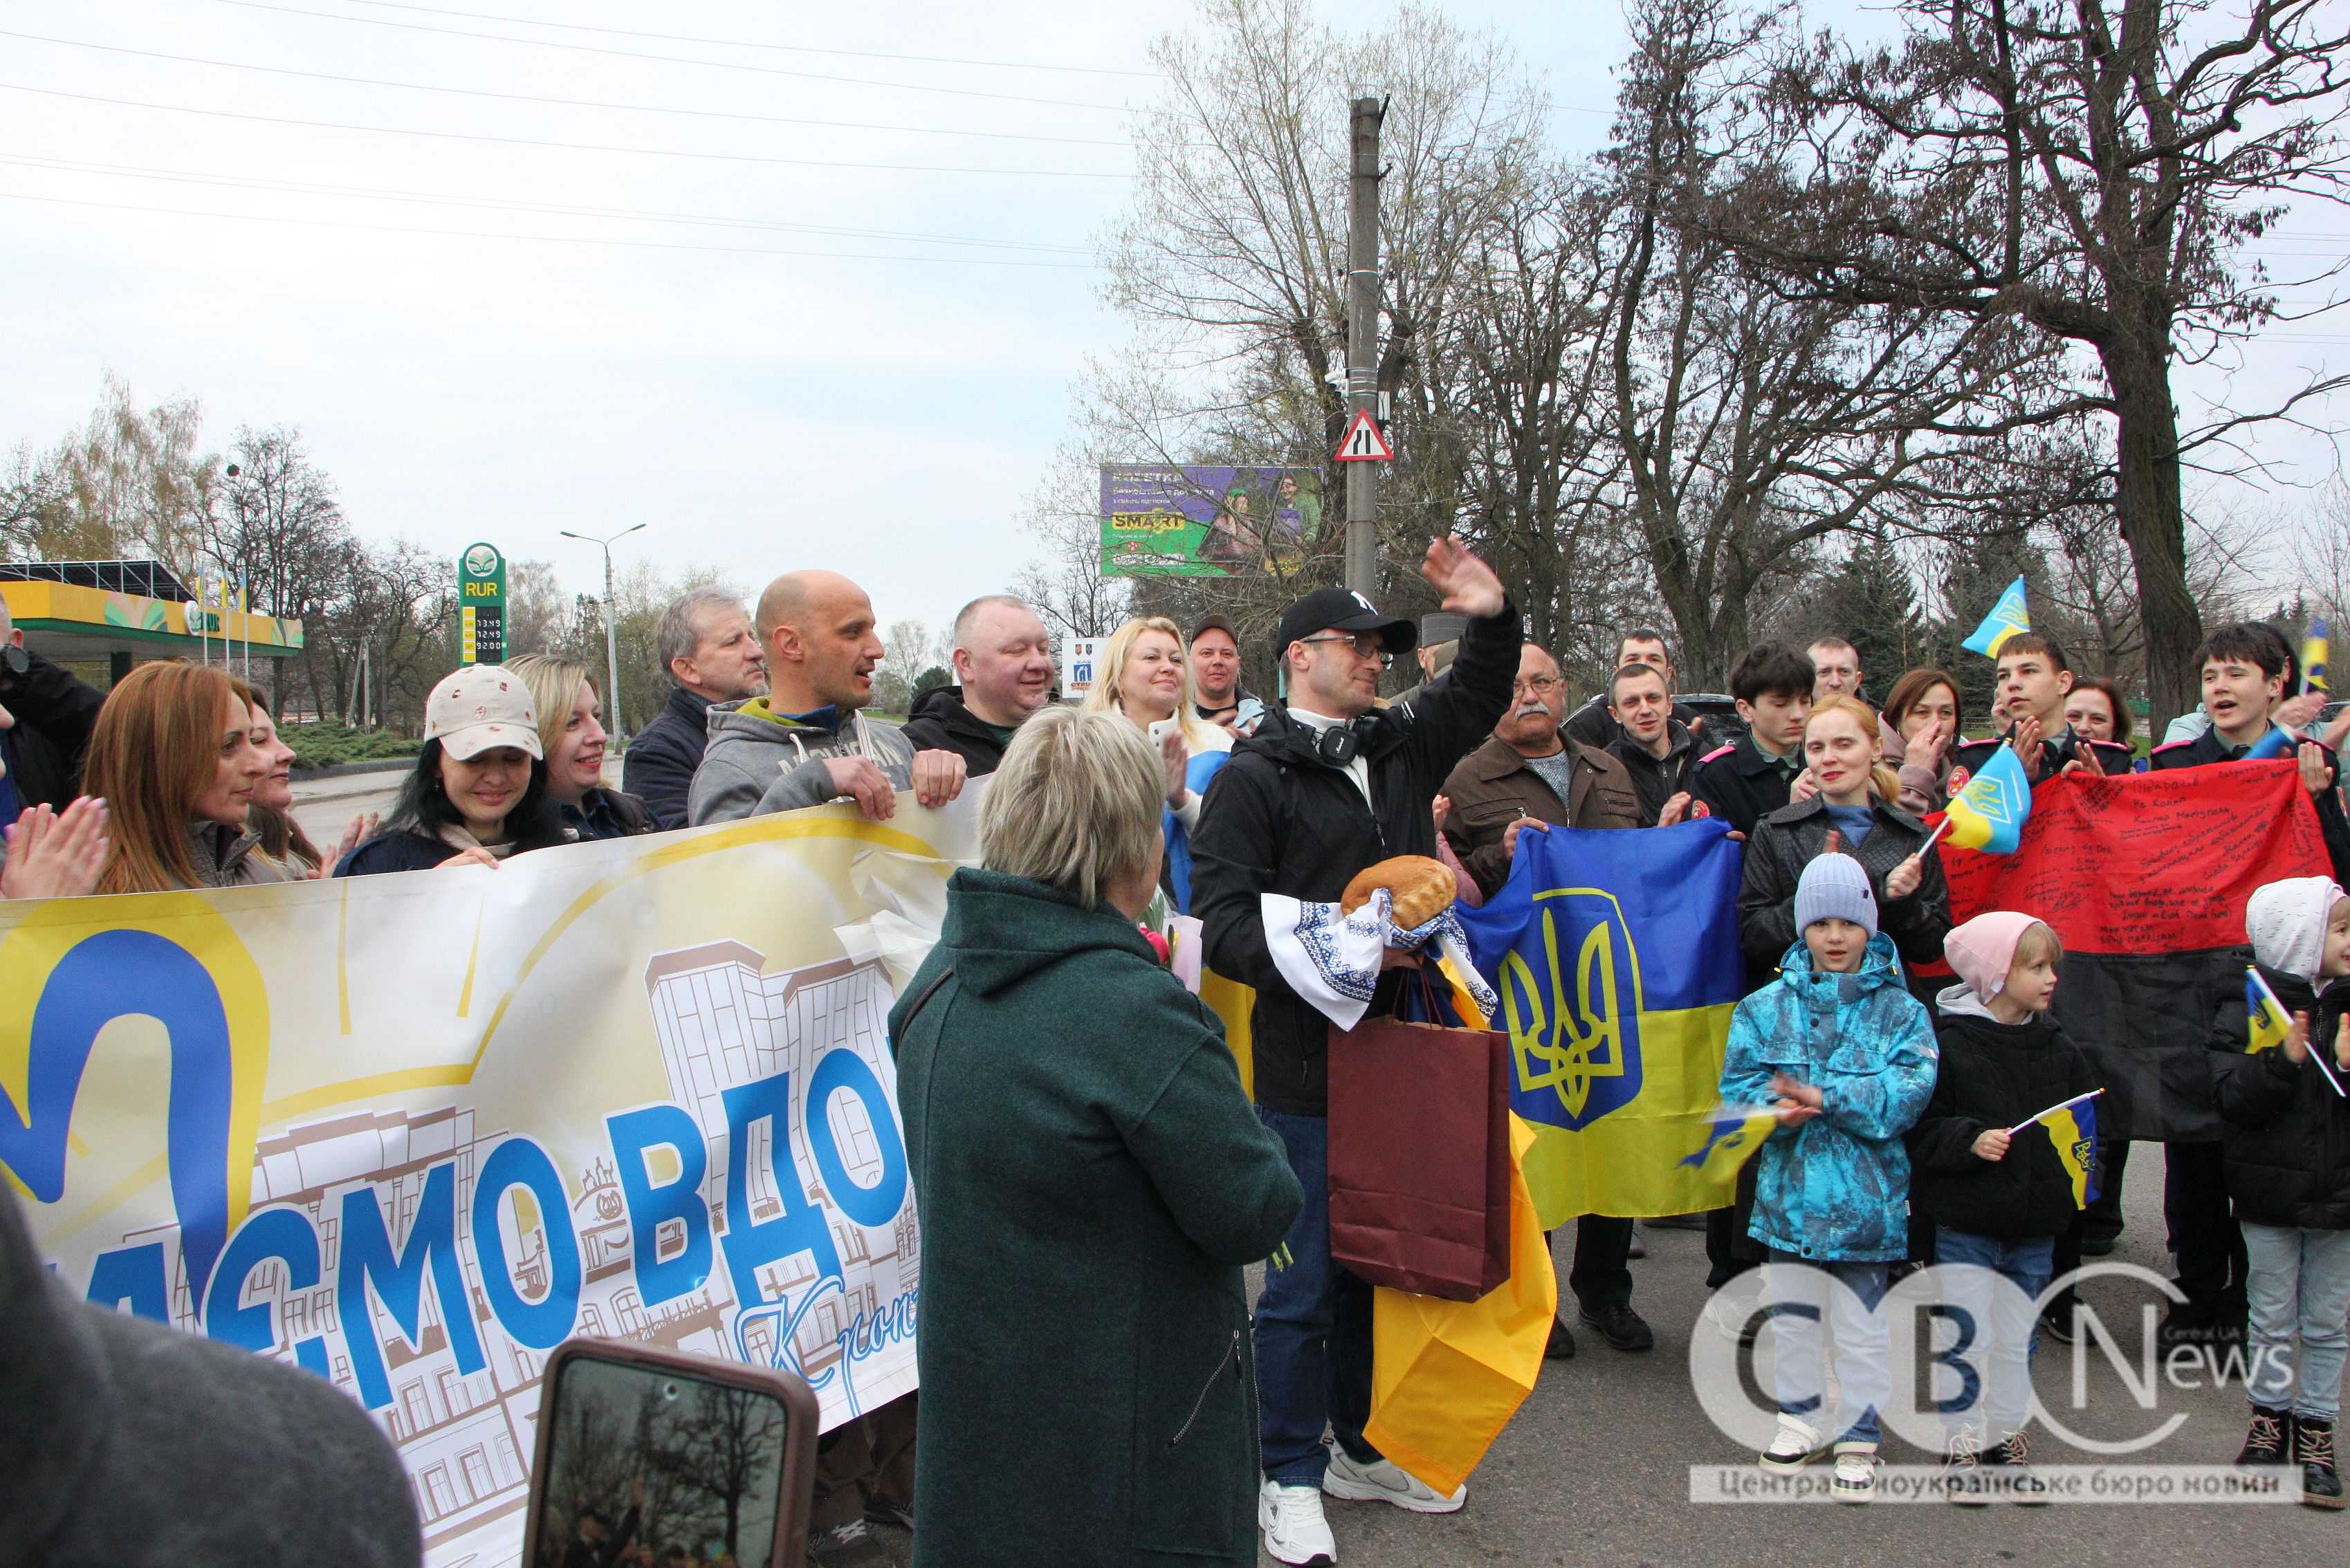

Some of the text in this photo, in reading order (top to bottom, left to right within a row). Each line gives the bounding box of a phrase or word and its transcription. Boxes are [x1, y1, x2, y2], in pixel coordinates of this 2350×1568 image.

[465, 582, 498, 596] RUR
[44, 1037, 908, 1410] АЄМО ВДО
[734, 1274, 919, 1416] Кроп
